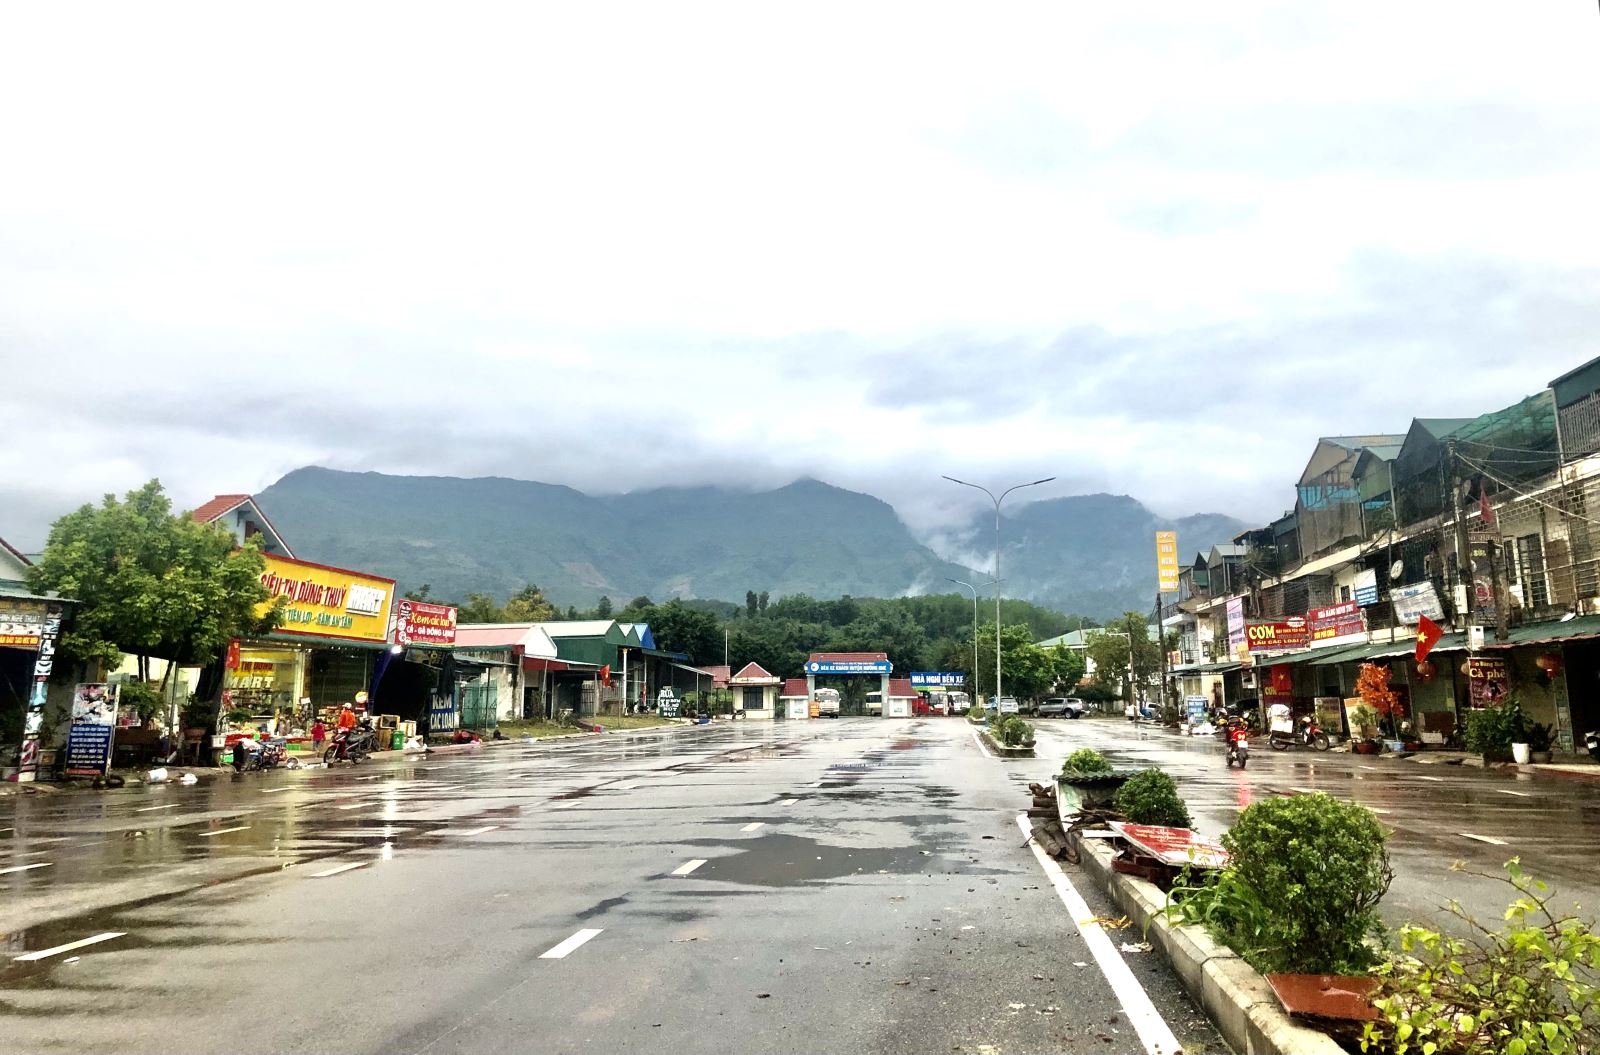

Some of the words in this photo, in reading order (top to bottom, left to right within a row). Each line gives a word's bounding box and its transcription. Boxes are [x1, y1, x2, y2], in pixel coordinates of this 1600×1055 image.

[411, 612, 430, 625] Kem
[1248, 624, 1276, 640] CƠM
[911, 673, 925, 684] NHÀ
[942, 673, 955, 684] BẾN
[1470, 667, 1484, 678] Cà
[225, 676, 274, 689] MART
[432, 693, 452, 710] KEM
